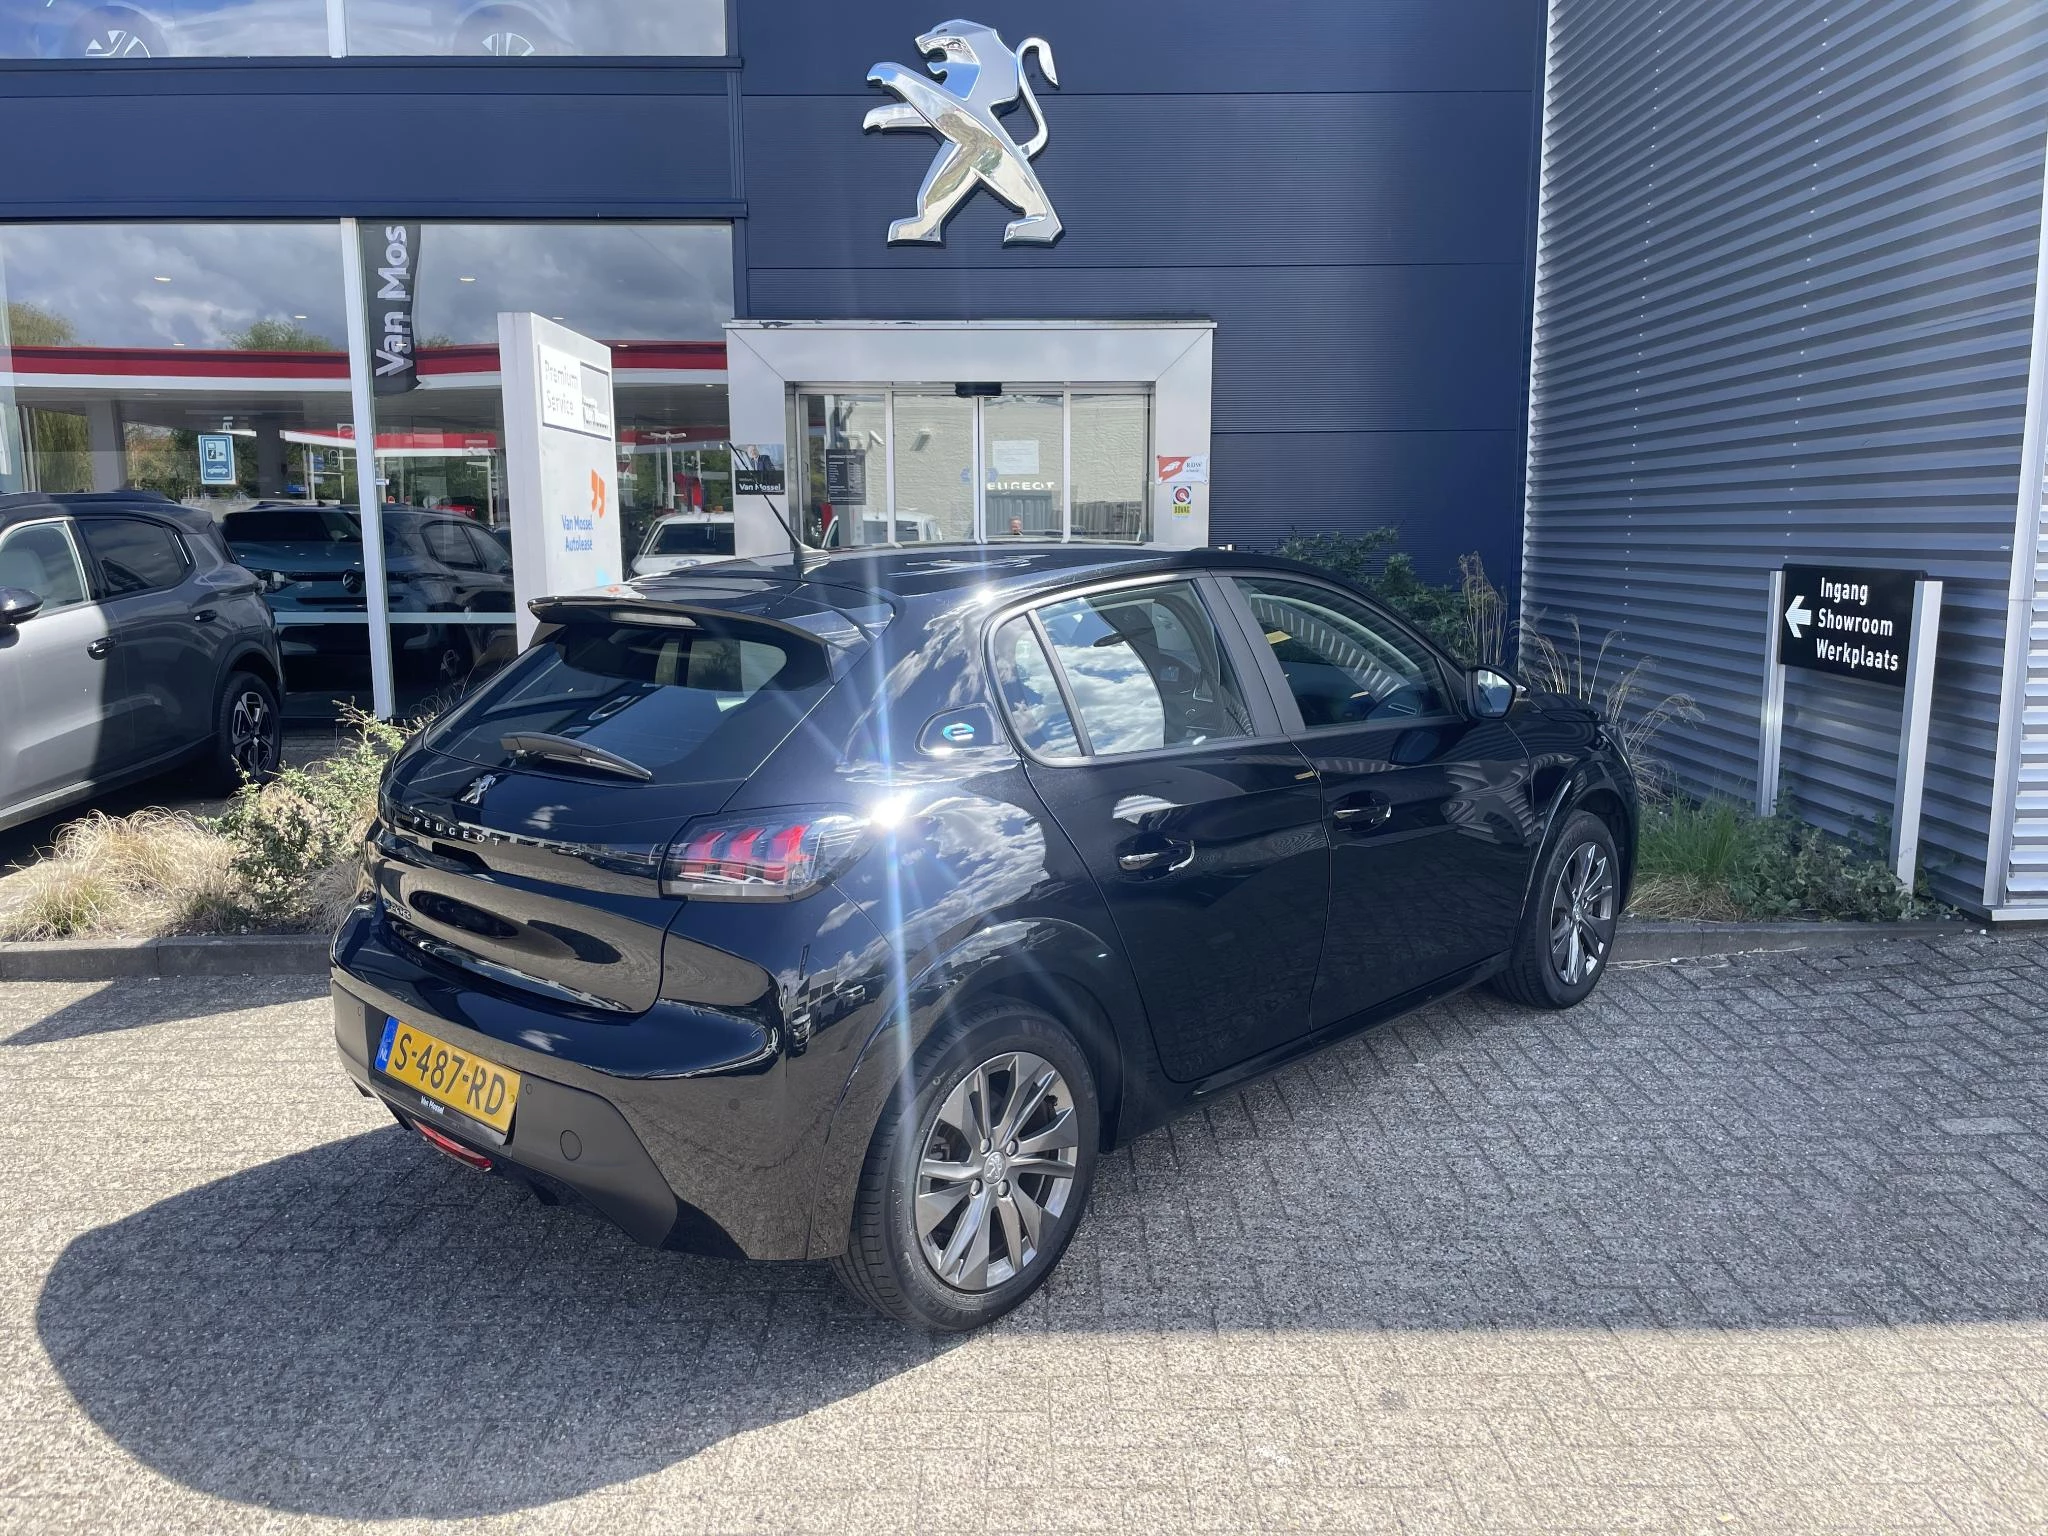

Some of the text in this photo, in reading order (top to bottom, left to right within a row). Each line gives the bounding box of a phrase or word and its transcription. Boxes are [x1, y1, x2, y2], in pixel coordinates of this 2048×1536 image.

[376, 311, 408, 377] Van
[544, 359, 579, 389] Premium
[546, 389, 574, 416] Service
[739, 483, 781, 491] Van Mossel
[562, 514, 593, 531] Van Mossel
[565, 536, 593, 552] Autolease
[1820, 577, 1869, 606] Ingang
[1817, 608, 1893, 637] Showroom
[1816, 638, 1899, 671] Werkplaats
[413, 816, 500, 846] PEUGEOT
[394, 1033, 506, 1115] S-487-RD
[420, 1095, 429, 1108] Van
